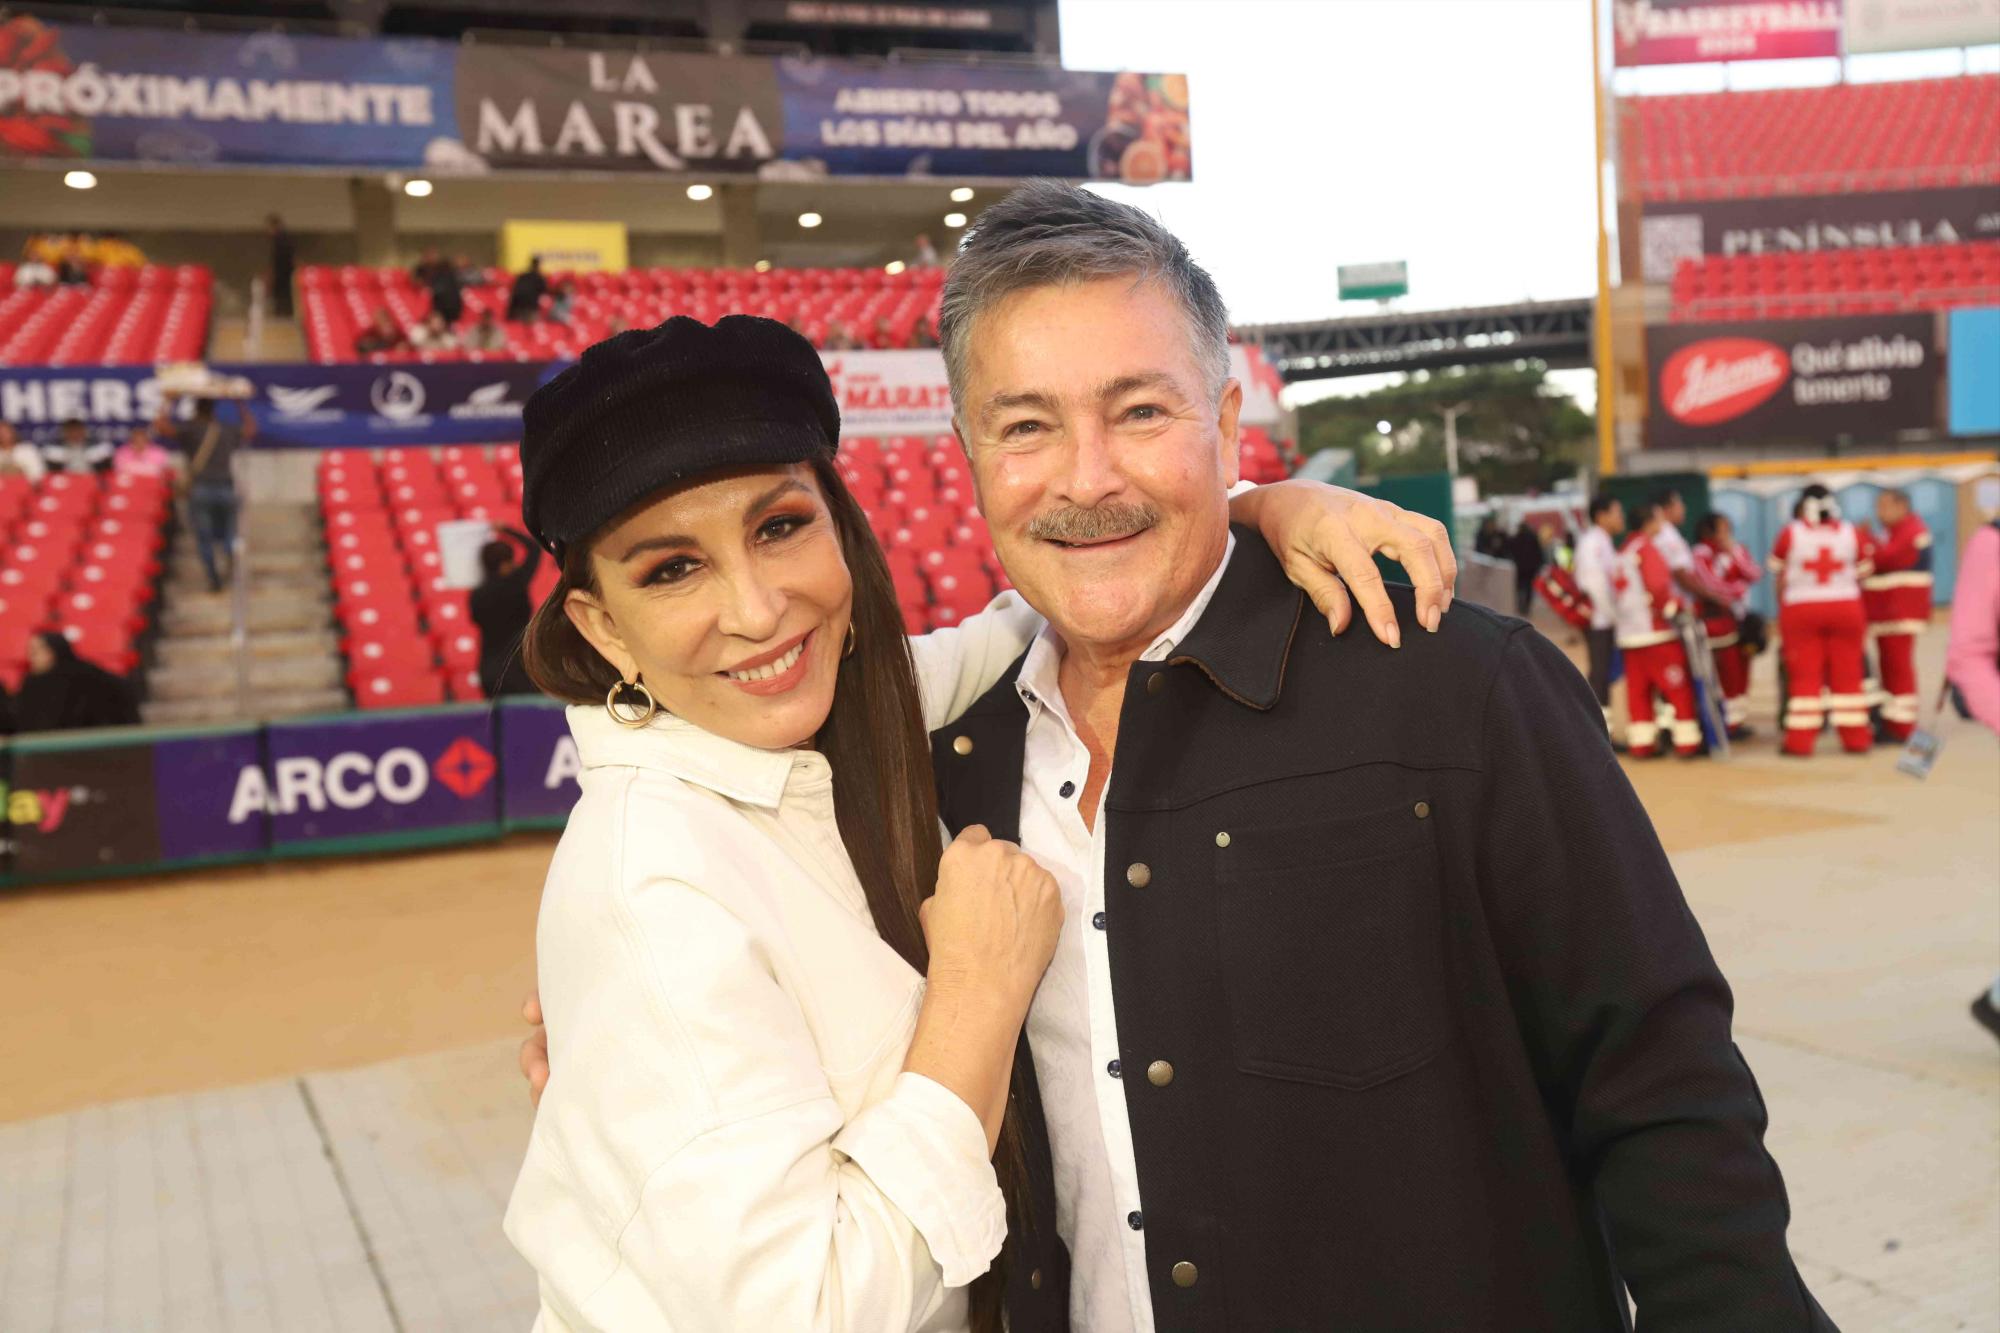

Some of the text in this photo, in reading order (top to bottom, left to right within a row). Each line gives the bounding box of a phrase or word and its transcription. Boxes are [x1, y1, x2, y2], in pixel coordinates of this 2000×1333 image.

[1646, 0, 1842, 37] BASKETBALL
[588, 52, 658, 93] LA
[0, 63, 434, 126] PRÓXIMAMENTE
[834, 88, 1062, 118] ABIERTO TODOS
[477, 98, 775, 170] MAREA
[820, 116, 1080, 151] LOS DÍAS DEL AÑO
[843, 384, 950, 410] MARAT
[228, 746, 431, 824] ARCO
